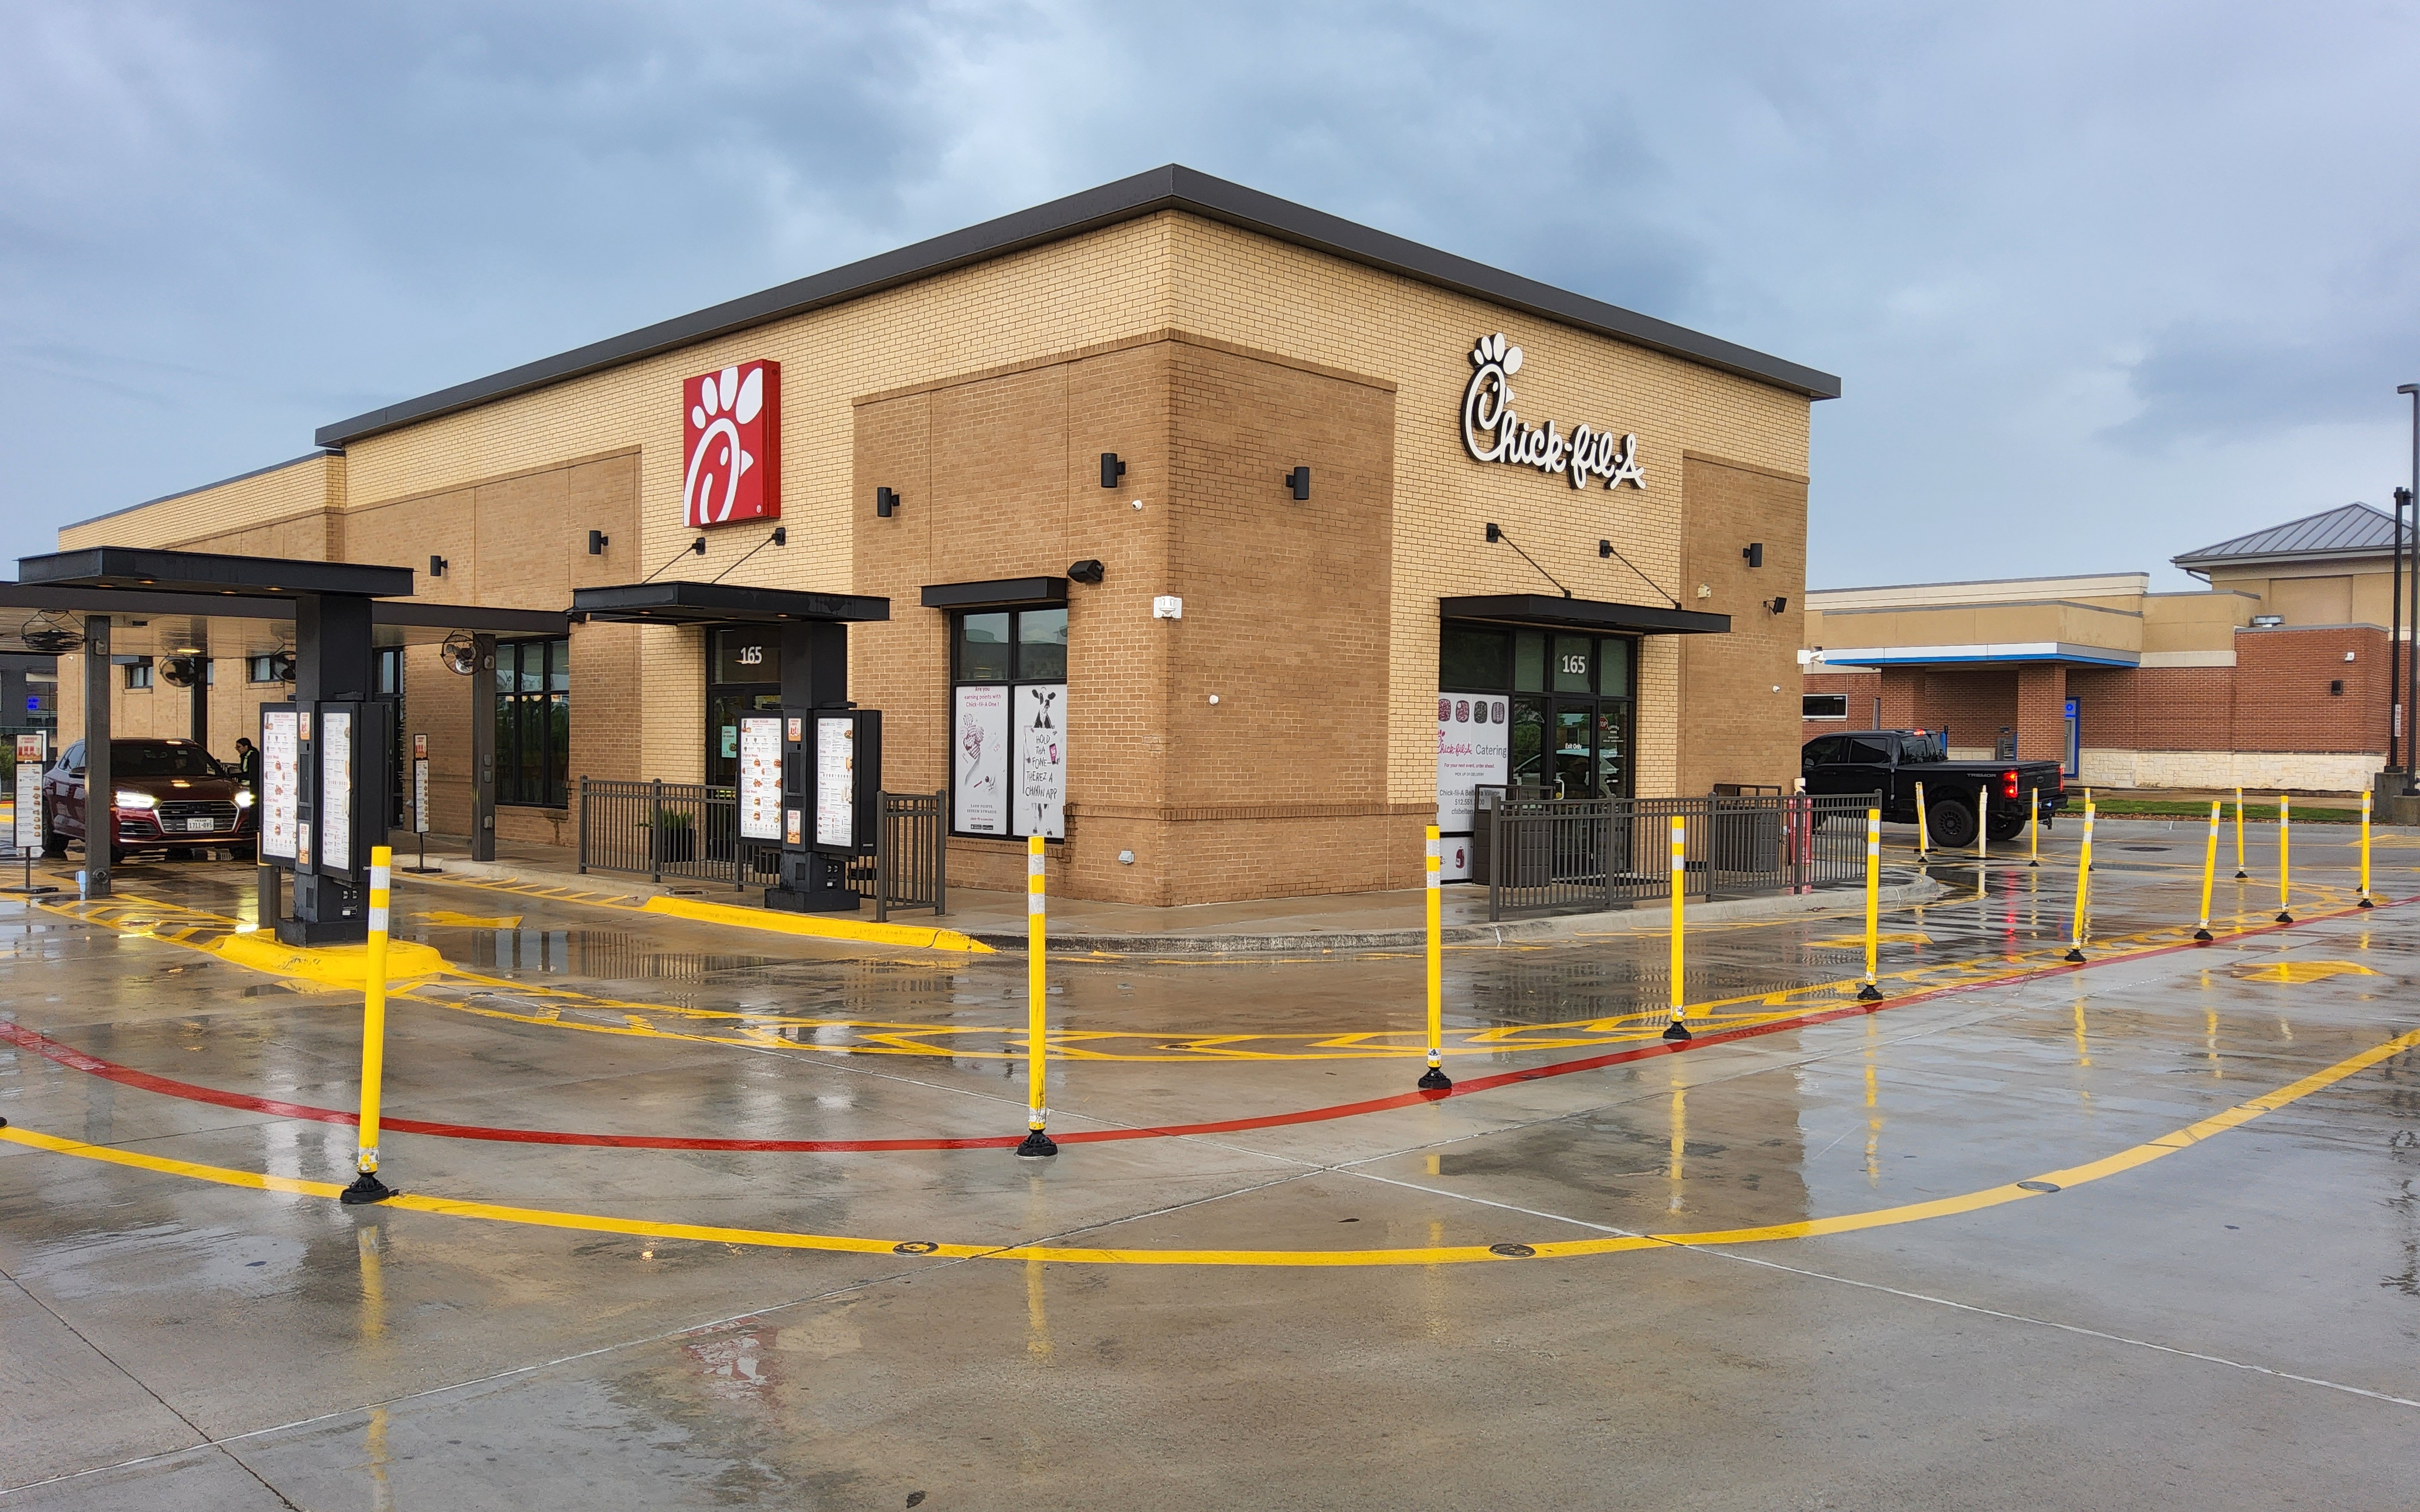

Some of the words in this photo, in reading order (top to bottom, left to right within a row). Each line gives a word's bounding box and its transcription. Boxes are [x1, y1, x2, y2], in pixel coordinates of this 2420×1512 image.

[1461, 332, 1646, 489] Chick-fil-A
[740, 646, 762, 664] 165
[1562, 655, 1586, 673] 165
[1036, 734, 1050, 744] HOLD
[1035, 745, 1045, 755] THA
[1476, 744, 1507, 758] Catering
[1027, 771, 1047, 782] THEREZ
[1049, 772, 1053, 784] A
[1025, 785, 1045, 798] CHIKIN
